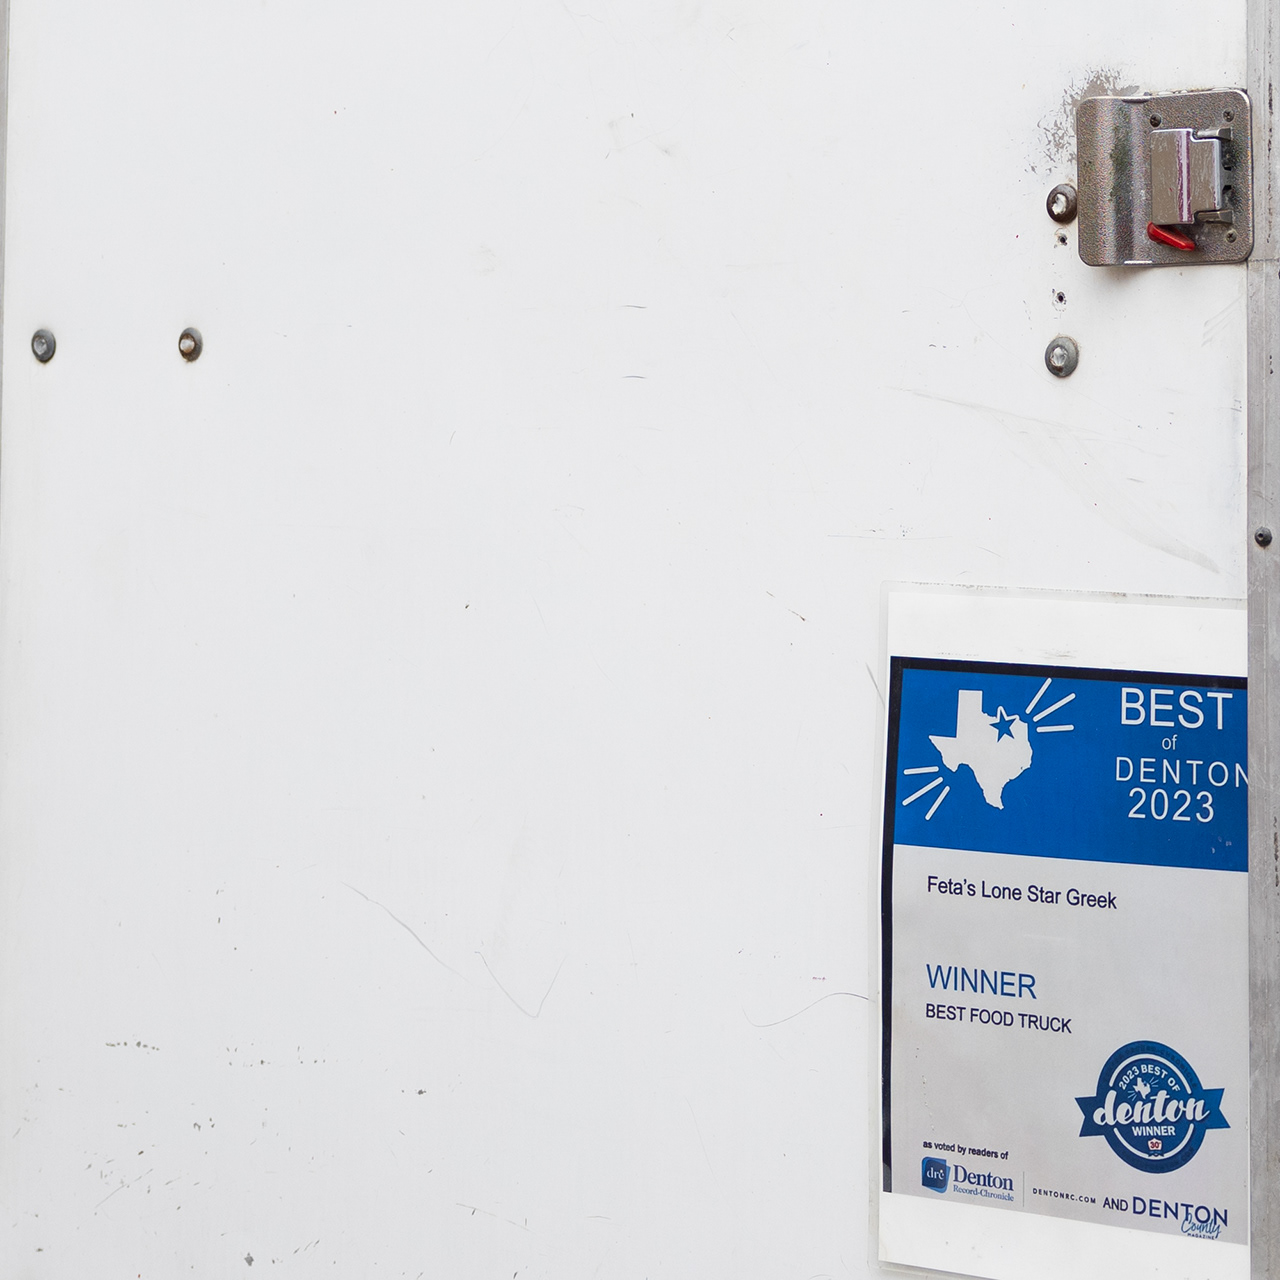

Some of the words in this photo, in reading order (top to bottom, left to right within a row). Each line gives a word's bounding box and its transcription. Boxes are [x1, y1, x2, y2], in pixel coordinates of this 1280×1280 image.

[1120, 687, 1233, 730] BEST
[1161, 734, 1178, 751] of
[1115, 756, 1248, 788] DENTON
[1128, 787, 1215, 823] 2023
[927, 875, 977, 897] Feta's
[981, 881, 1023, 901] Lone
[1027, 885, 1061, 905] Star
[1066, 889, 1118, 910] Greek
[926, 963, 1037, 999] WINNER
[926, 1003, 966, 1022] BEST
[970, 1008, 1014, 1027] FOOD
[1018, 1012, 1072, 1034] TRUCK
[1118, 1066, 1140, 1090] 2023
[1141, 1064, 1168, 1079] BEST
[1167, 1077, 1181, 1092] OF
[1093, 1089, 1211, 1126] denton
[1132, 1125, 1176, 1136] WINNER
[923, 1141, 933, 1149] as
[934, 1142, 956, 1152] voted
[957, 1144, 967, 1155] by
[968, 1147, 999, 1159] readers
[1000, 1151, 1009, 1160] of
[926, 1167, 945, 1181] drc
[953, 1164, 1014, 1191] Denton
[953, 1184, 1015, 1202] Record-Chronicle
[1032, 1187, 1097, 1204] DENTONRC.COM
[1103, 1197, 1129, 1212] AND
[1132, 1196, 1228, 1227] DENTON
[1181, 1212, 1222, 1239] County
